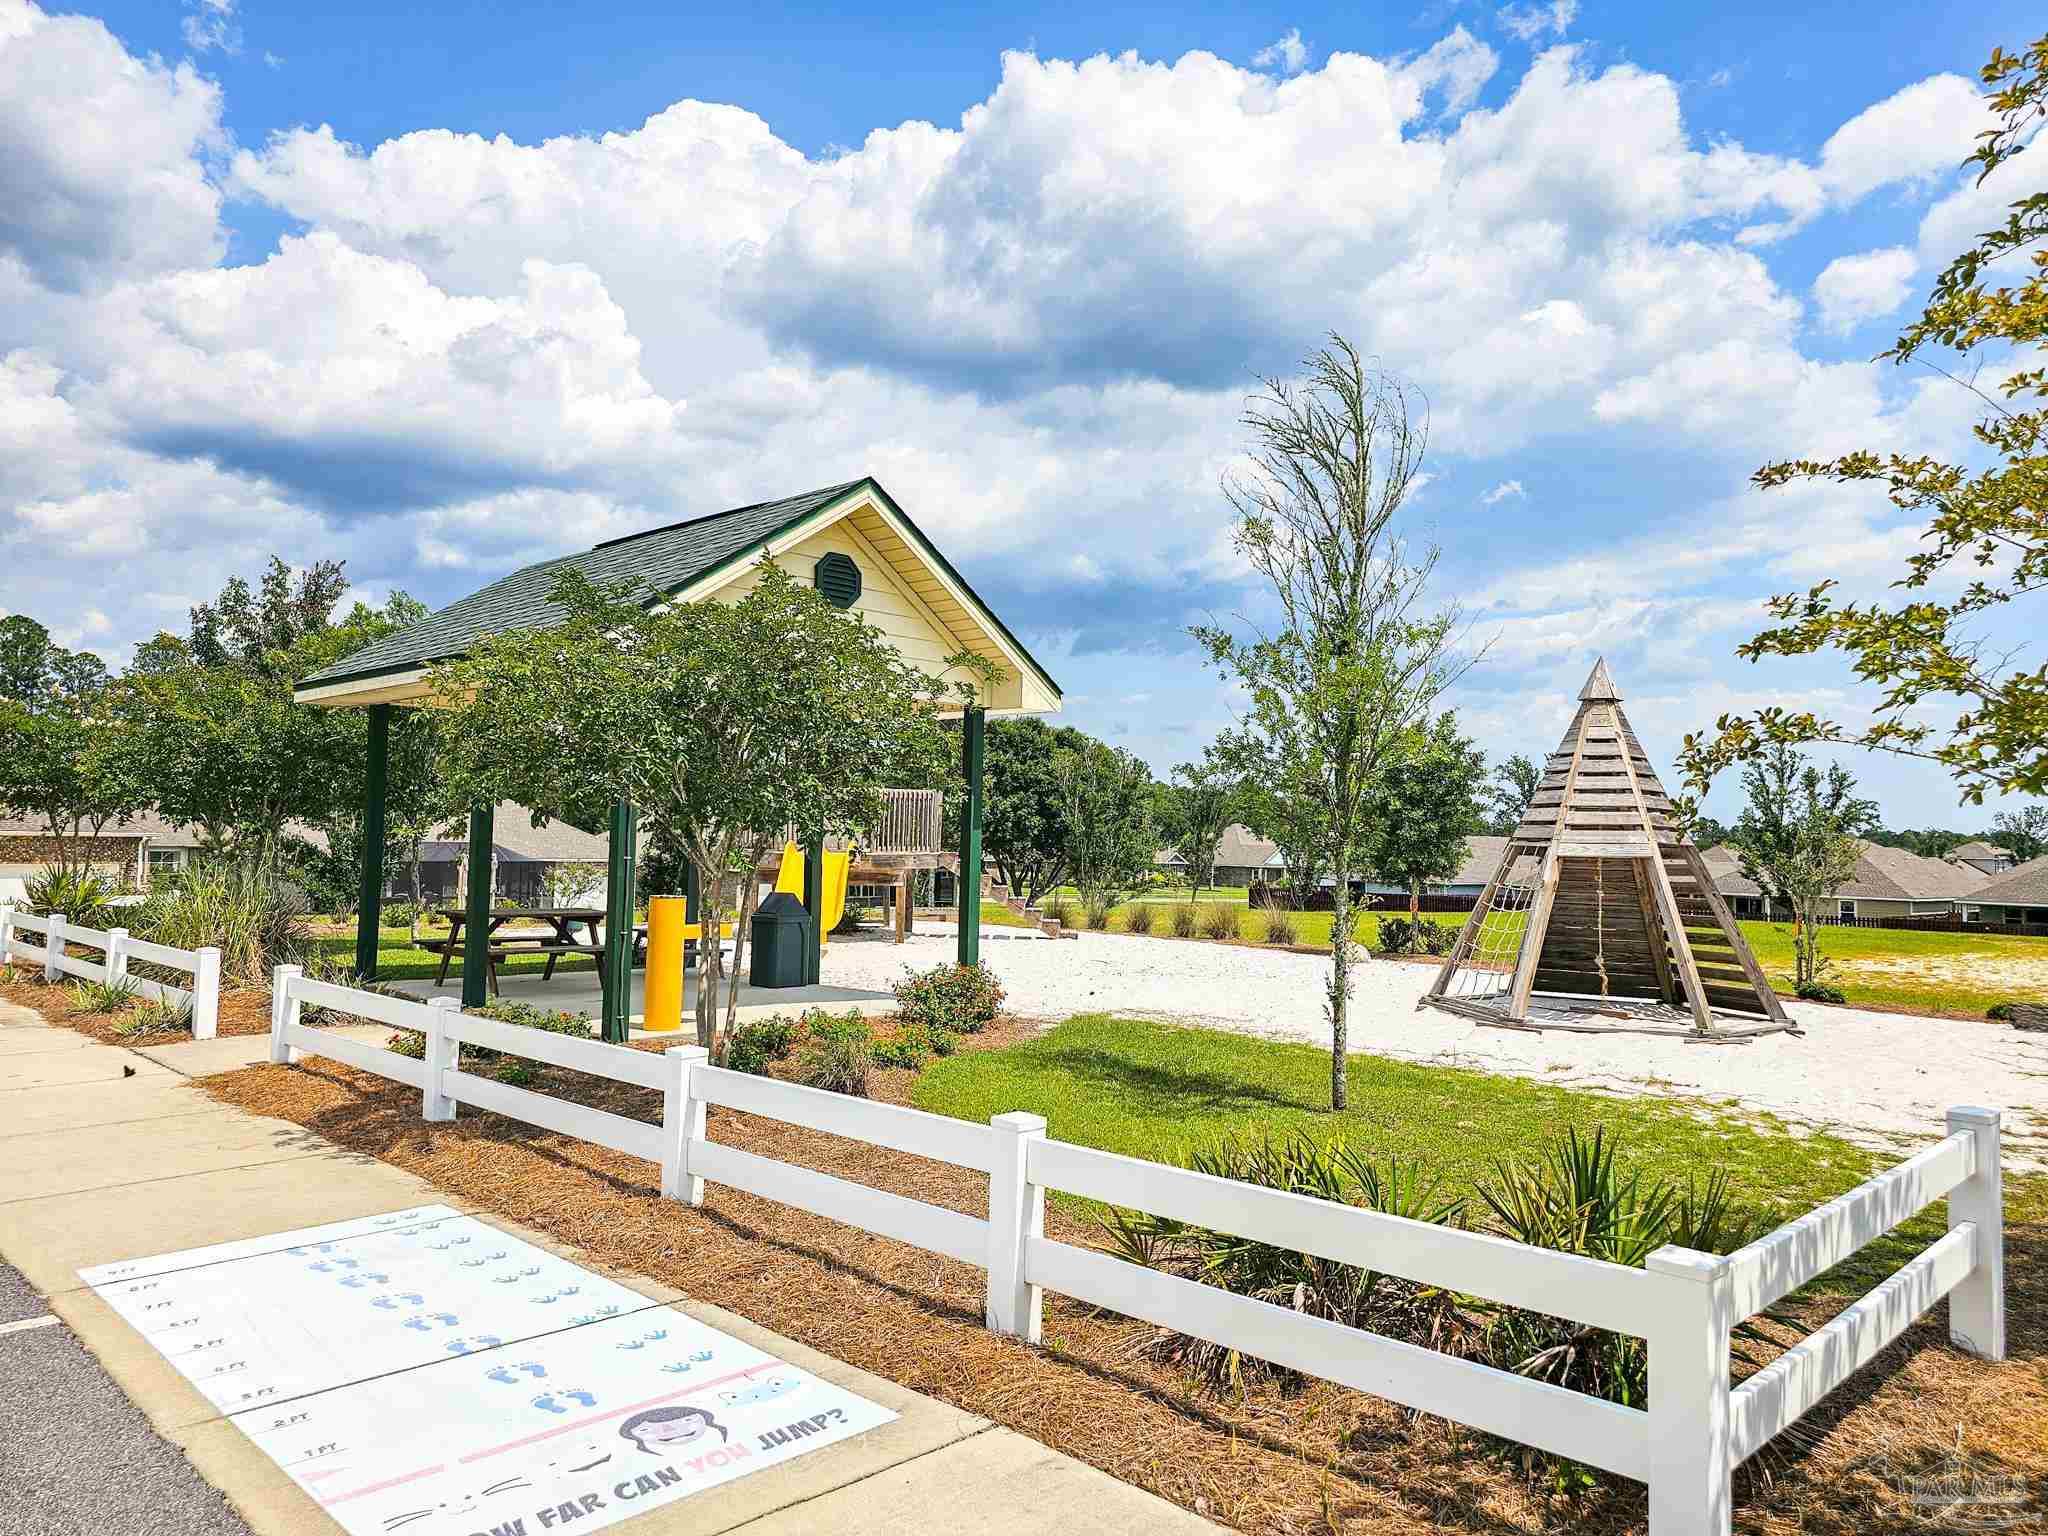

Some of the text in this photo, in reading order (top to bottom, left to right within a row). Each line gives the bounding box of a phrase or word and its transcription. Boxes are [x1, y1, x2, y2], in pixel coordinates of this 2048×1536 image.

[257, 1386, 274, 1396] FT
[290, 1411, 309, 1423] FT
[317, 1442, 337, 1454] FT
[536, 1493, 607, 1528] FAR
[614, 1466, 683, 1500] CAN
[685, 1442, 752, 1473] YOU
[757, 1408, 849, 1451] JUMP?
